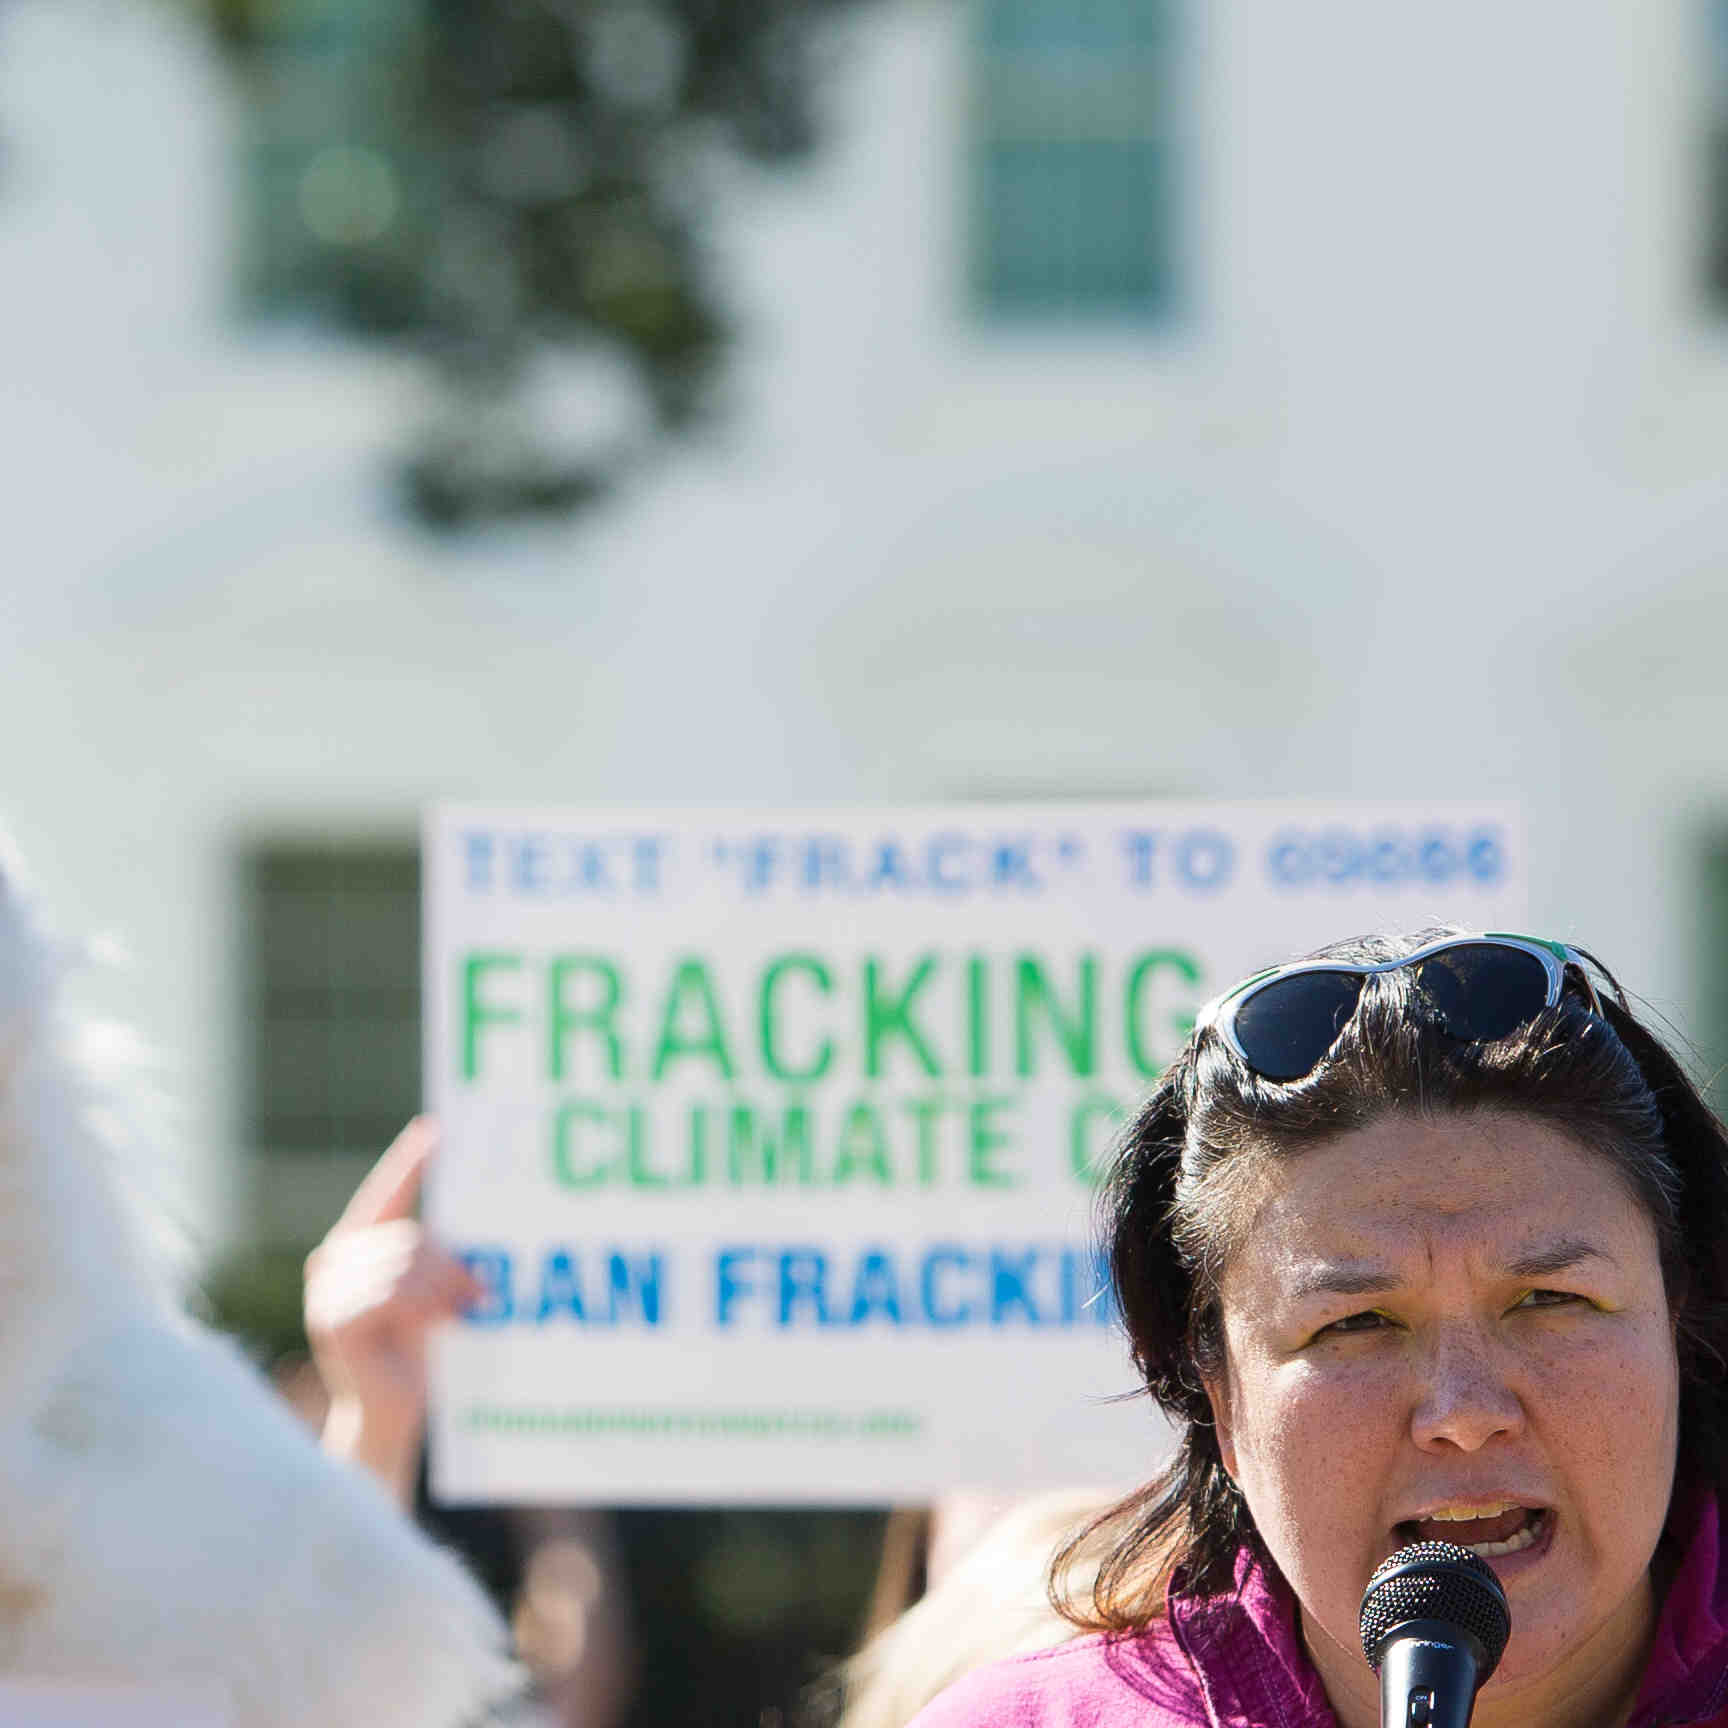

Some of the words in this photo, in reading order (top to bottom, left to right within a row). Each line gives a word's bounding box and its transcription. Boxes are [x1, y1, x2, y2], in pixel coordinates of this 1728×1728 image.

[464, 830, 664, 892] TEXT
[1126, 828, 1236, 892] TO
[458, 946, 1208, 1084] FRACKING
[550, 1096, 1016, 1192] CLIMATE
[462, 1242, 664, 1328] BAN
